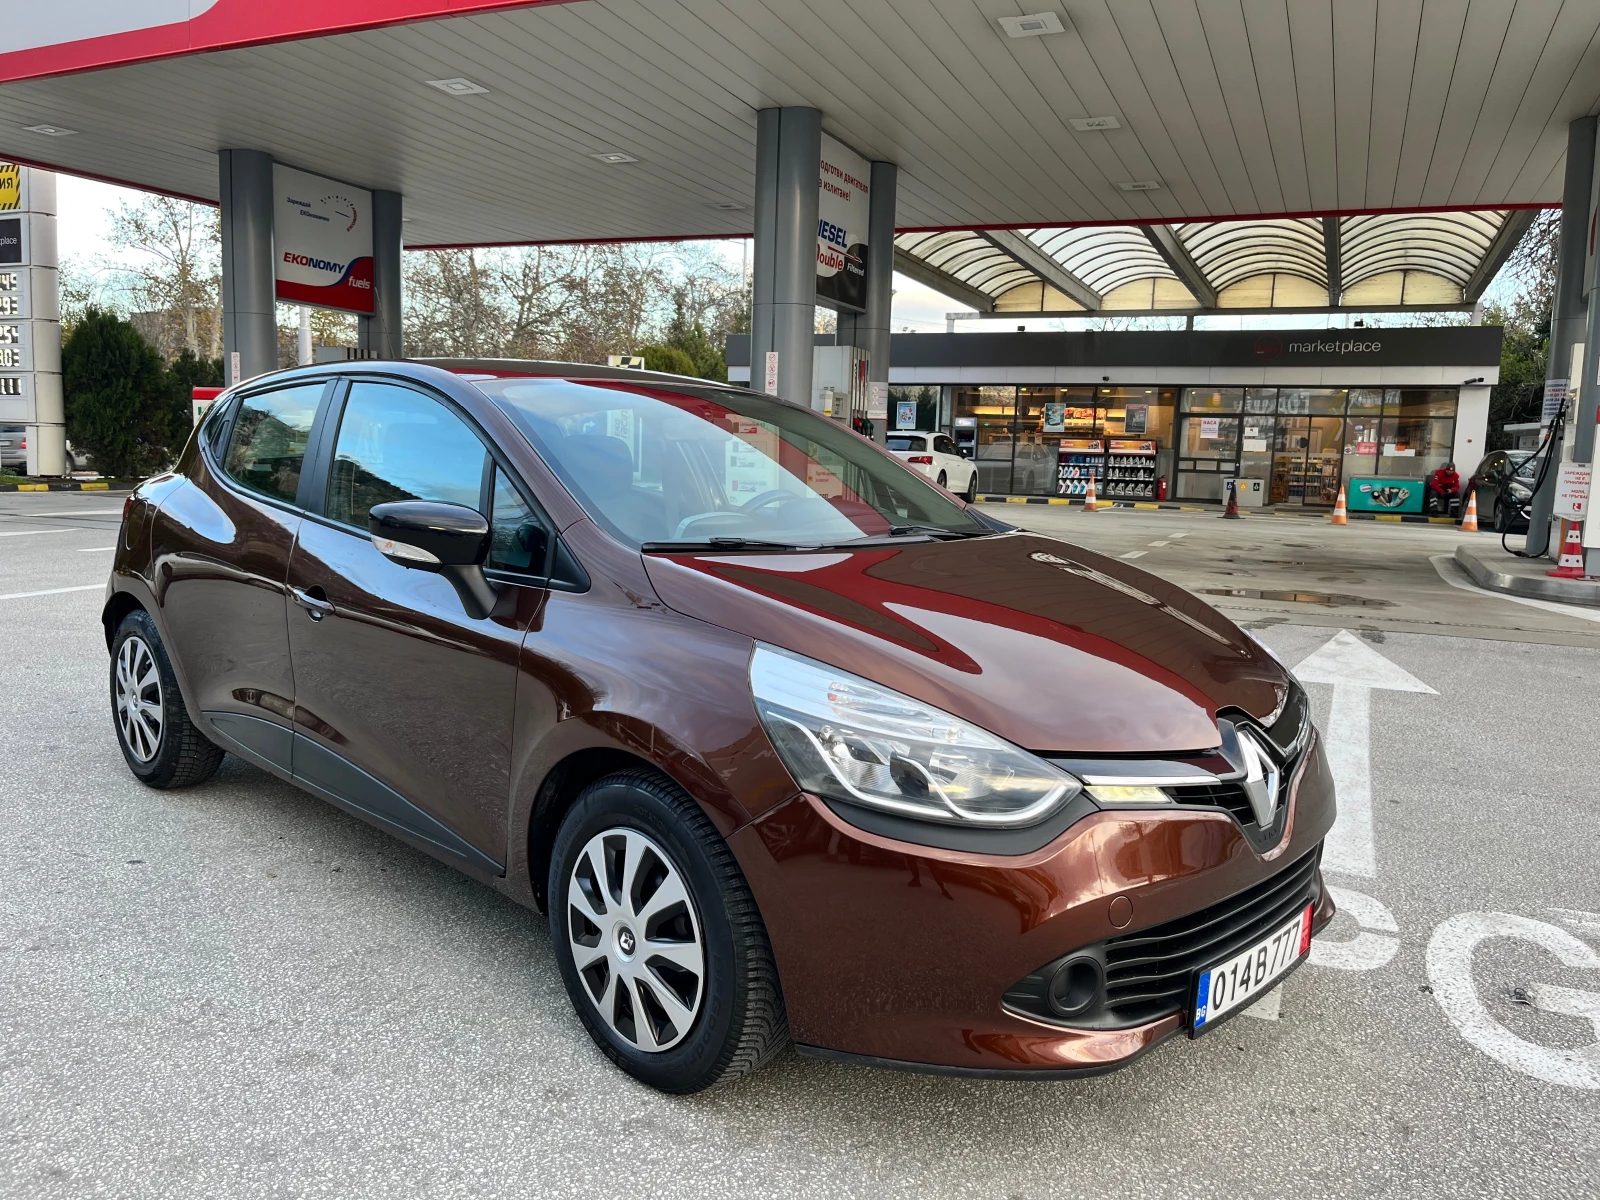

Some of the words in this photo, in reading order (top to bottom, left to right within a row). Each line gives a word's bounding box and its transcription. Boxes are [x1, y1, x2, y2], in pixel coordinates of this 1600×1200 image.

[283, 251, 346, 274] EKONOMY
[348, 275, 371, 290] fuels
[1288, 339, 1382, 355] marketplace
[1257, 828, 1278, 845] CLIO
[1212, 919, 1301, 1011] 014B777
[1195, 1005, 1207, 1020] BG
